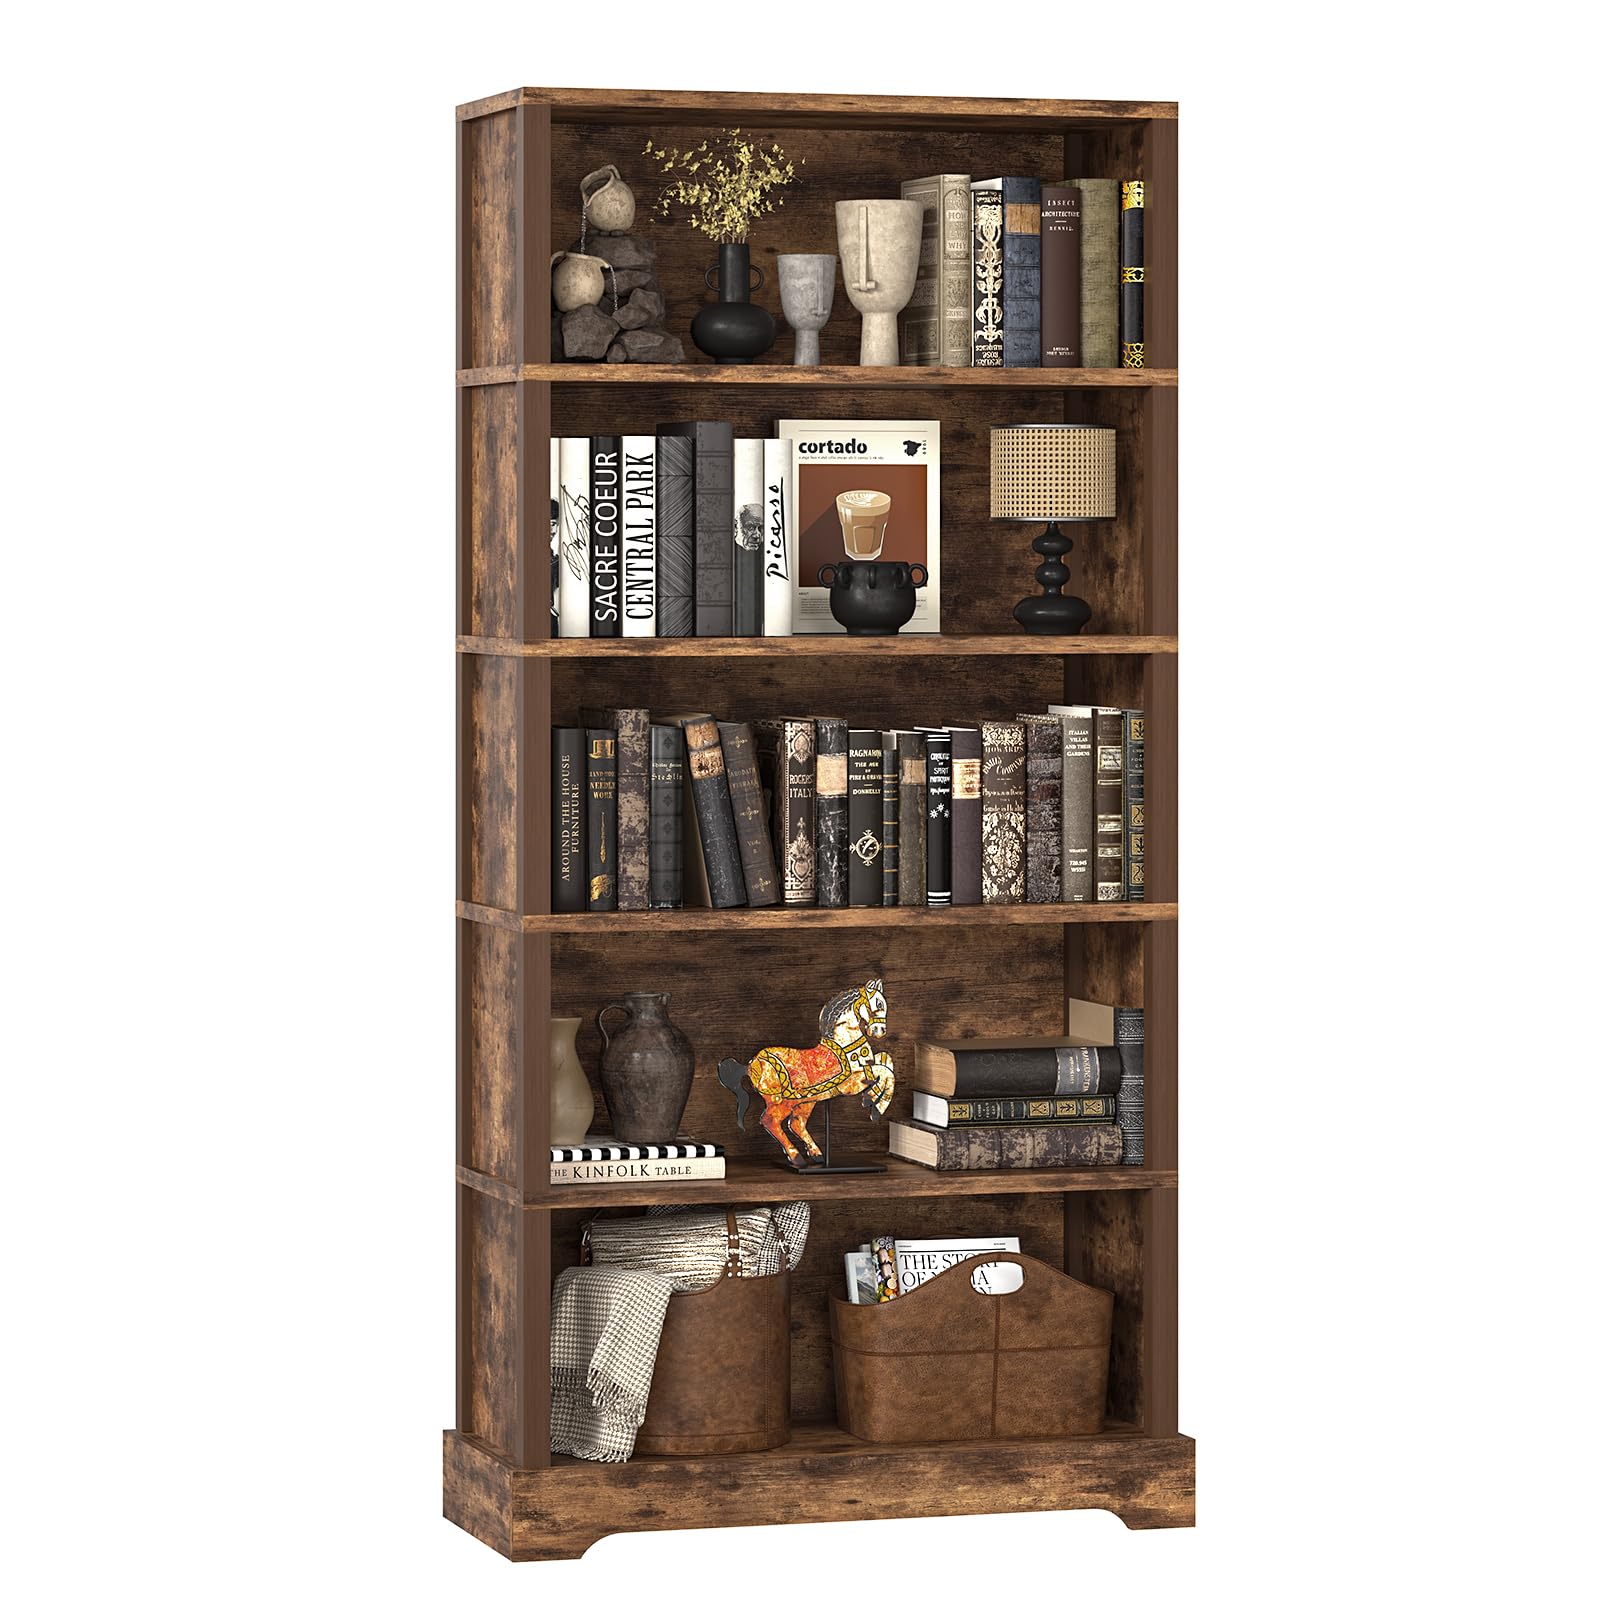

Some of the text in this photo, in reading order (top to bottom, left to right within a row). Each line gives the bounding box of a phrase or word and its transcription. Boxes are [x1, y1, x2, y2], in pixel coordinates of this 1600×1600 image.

[798, 438, 868, 454] cortado
[594, 452, 618, 622] SACRE COEUR
[625, 453, 654, 620] CENTRAL PARK
[789, 788, 813, 798] ITALY
[561, 754, 571, 882] AROUND THE HOUSE
[571, 783, 580, 854] FURNITURE
[573, 1164, 650, 1178] KINFOLK
[655, 1166, 692, 1176] TABLE
[900, 1254, 938, 1270] THE
